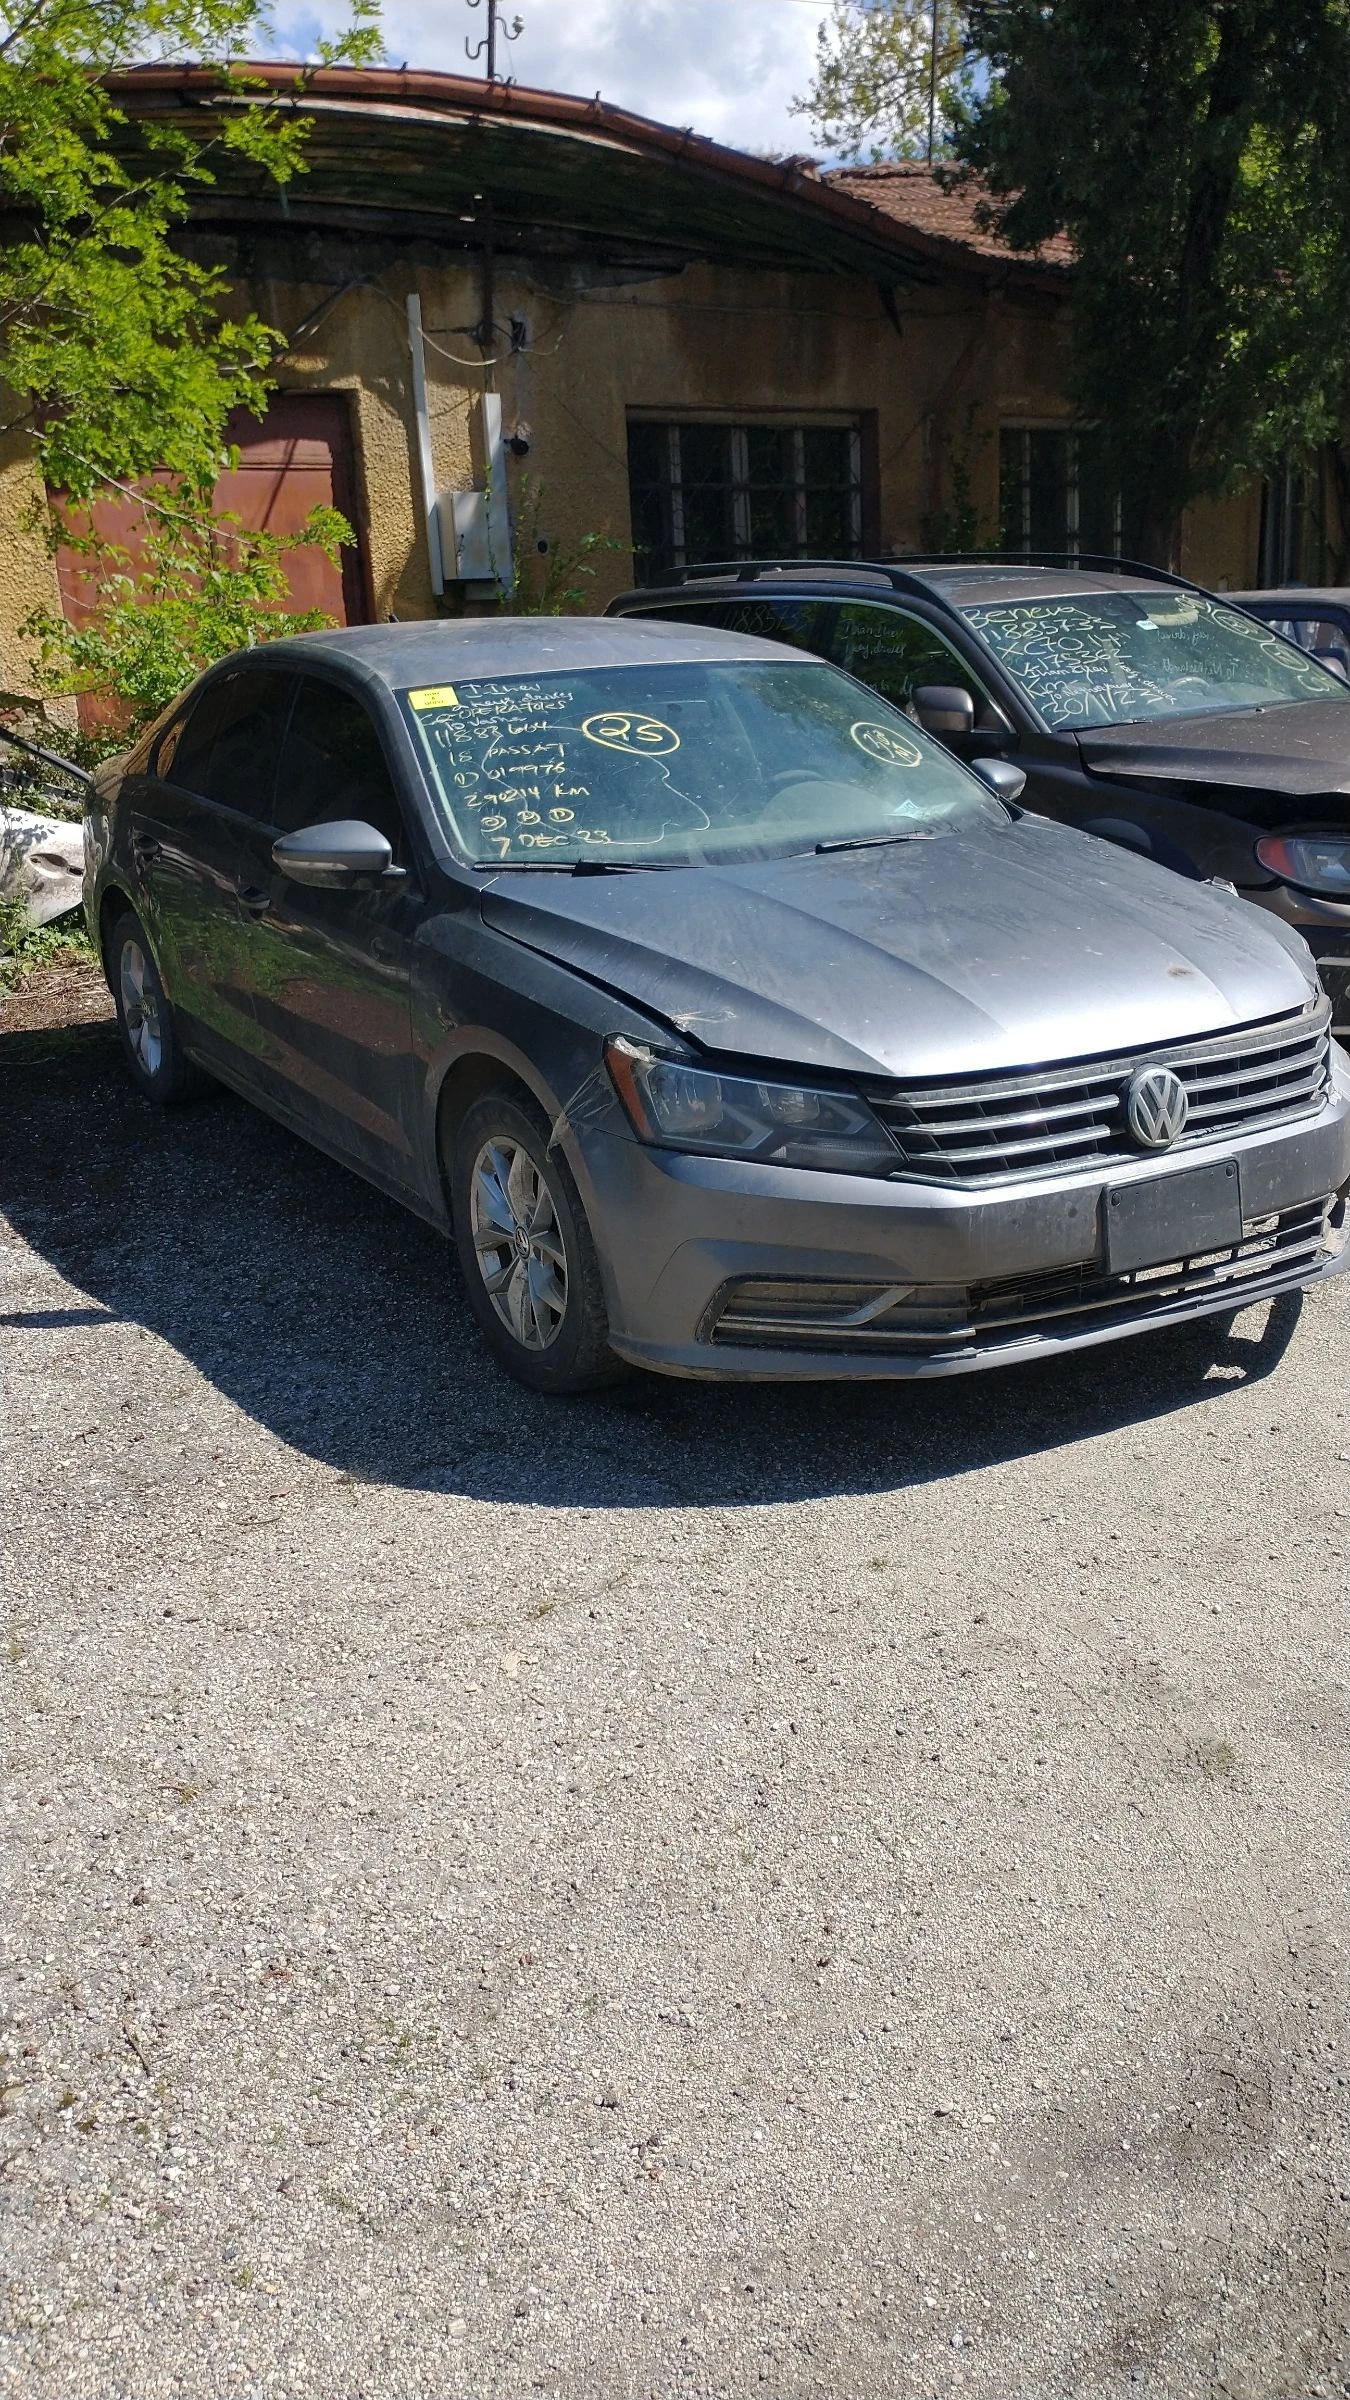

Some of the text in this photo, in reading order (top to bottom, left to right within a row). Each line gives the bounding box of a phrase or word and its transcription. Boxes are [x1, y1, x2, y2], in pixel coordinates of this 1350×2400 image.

[996, 636, 1084, 660] XC70
[487, 741, 570, 759] PASSAT
[518, 832, 569, 848] DEC
